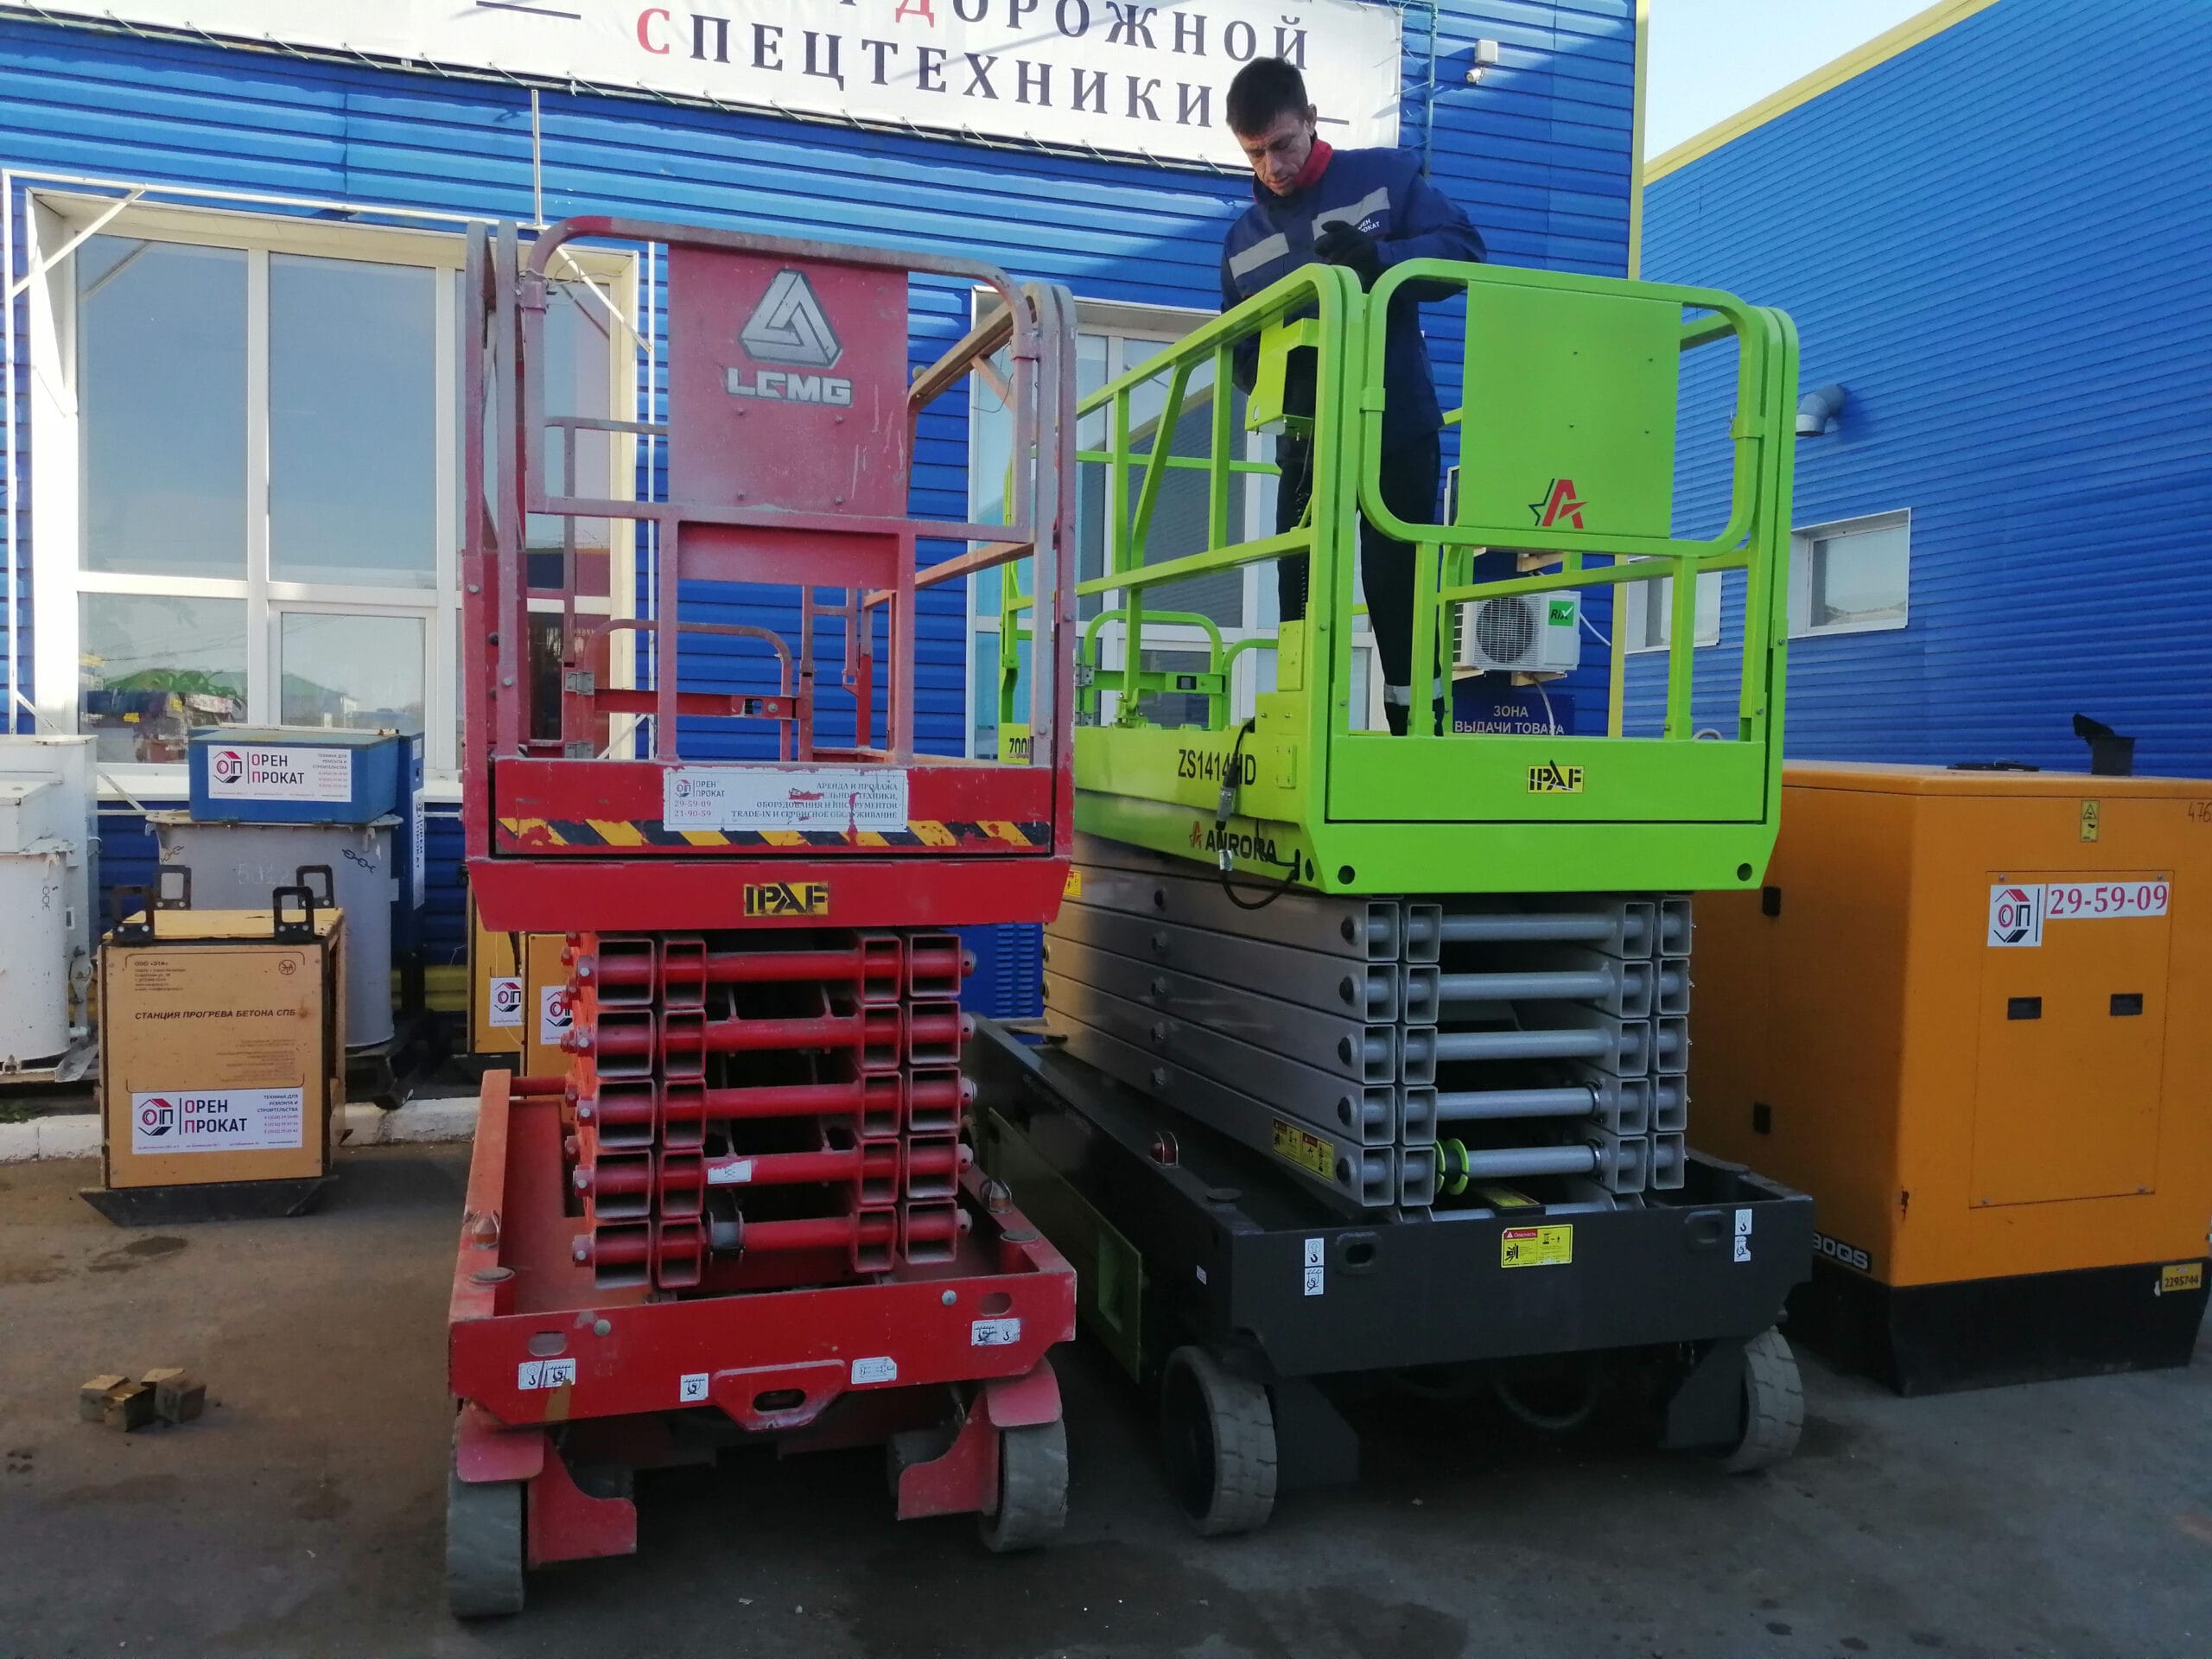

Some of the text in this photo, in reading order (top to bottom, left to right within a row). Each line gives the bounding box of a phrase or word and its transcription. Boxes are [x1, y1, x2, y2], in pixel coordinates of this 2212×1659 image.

[637, 8, 1212, 129] СПЕЦТЕХНИКИ
[1361, 220, 1380, 232] ОКАТ
[1493, 705, 1529, 717] ЗОНА
[1454, 721, 1511, 734] ВЫДАЧИ
[251, 753, 288, 767] ОРЕН
[251, 771, 305, 785] ПРОКАТ
[1529, 760, 1581, 791] IPAF
[817, 782, 849, 791] АРЕНДА
[674, 800, 712, 809] 29-59-09
[832, 801, 898, 810] ИНСРУМЕНТОВ
[746, 881, 827, 914] IPAF
[2050, 884, 2168, 915] 29-59-09
[135, 1012, 181, 1020] СТАНЦИЯ
[182, 1010, 233, 1019] ПРОГРЕВА
[236, 1009, 275, 1018] БЕТОНА
[184, 1099, 228, 1114] ОРЕН
[184, 1118, 248, 1134] ПРОКАТ
